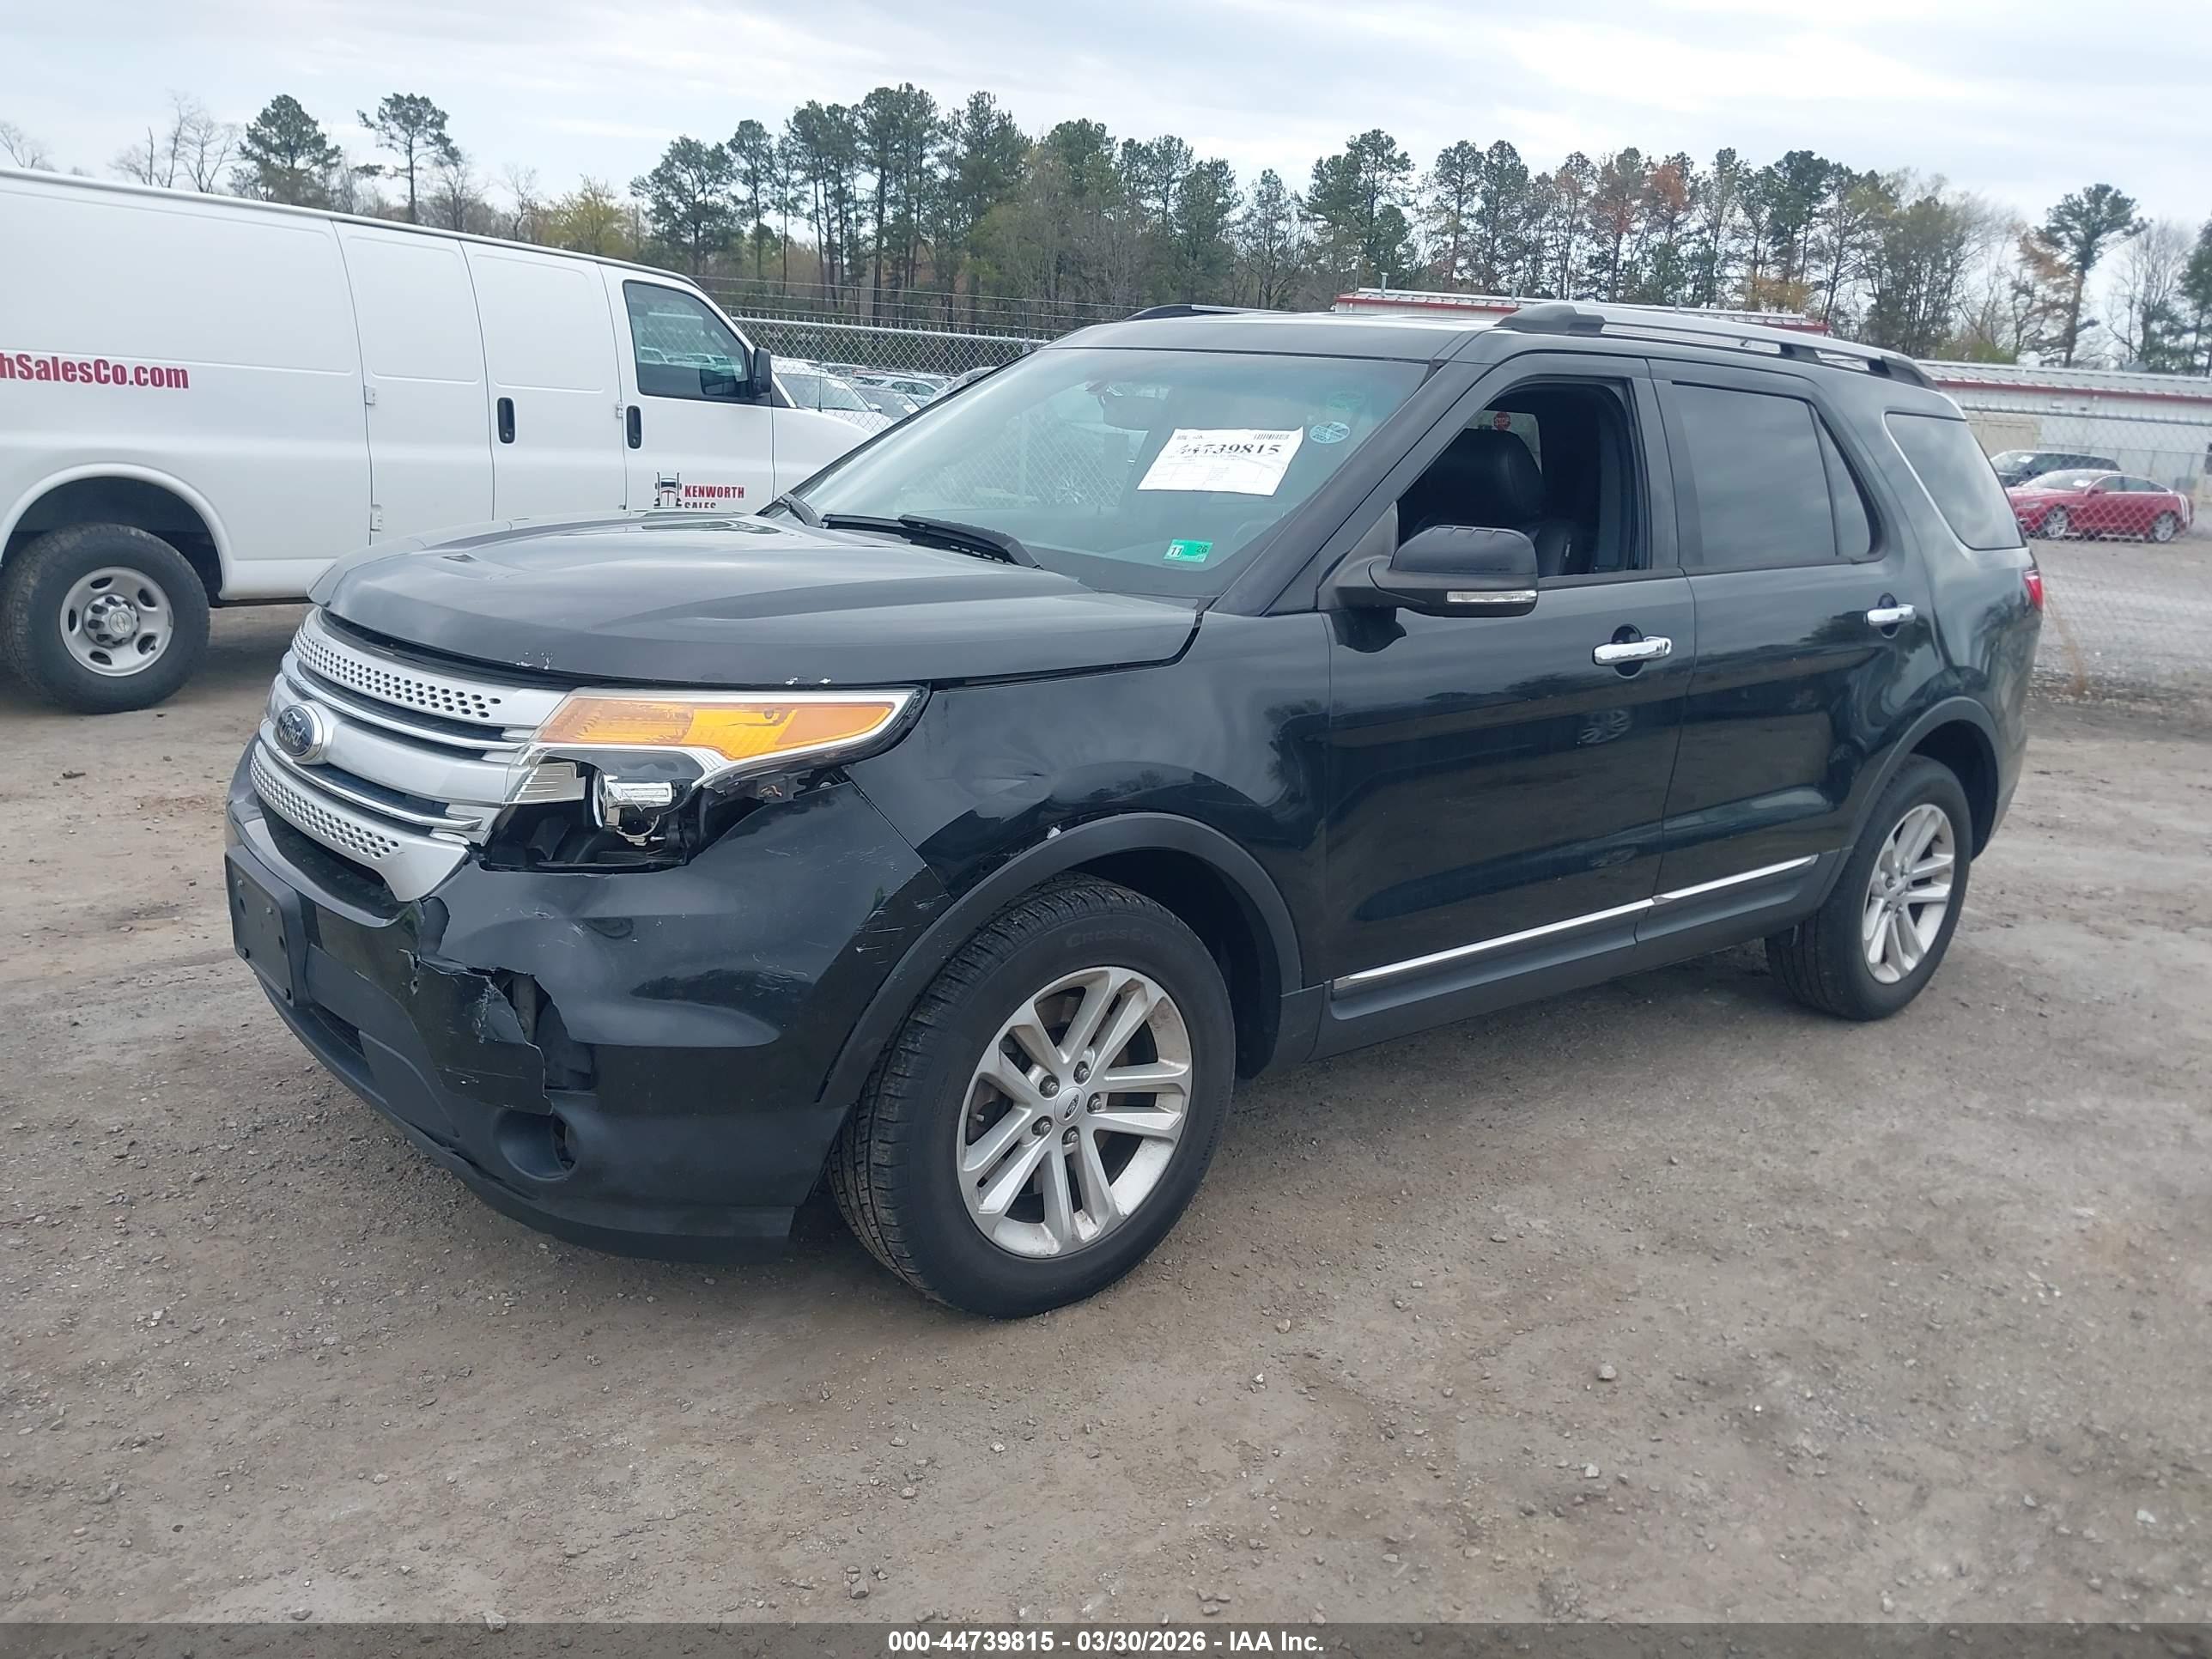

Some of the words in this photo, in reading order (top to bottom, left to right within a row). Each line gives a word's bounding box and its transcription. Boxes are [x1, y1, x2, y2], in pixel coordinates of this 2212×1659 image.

[0, 352, 189, 389] hSalesCo.com
[684, 485, 744, 498] KENWORTH
[1170, 546, 1183, 556] 11
[1196, 544, 1208, 554] 26
[279, 710, 306, 747] Ford
